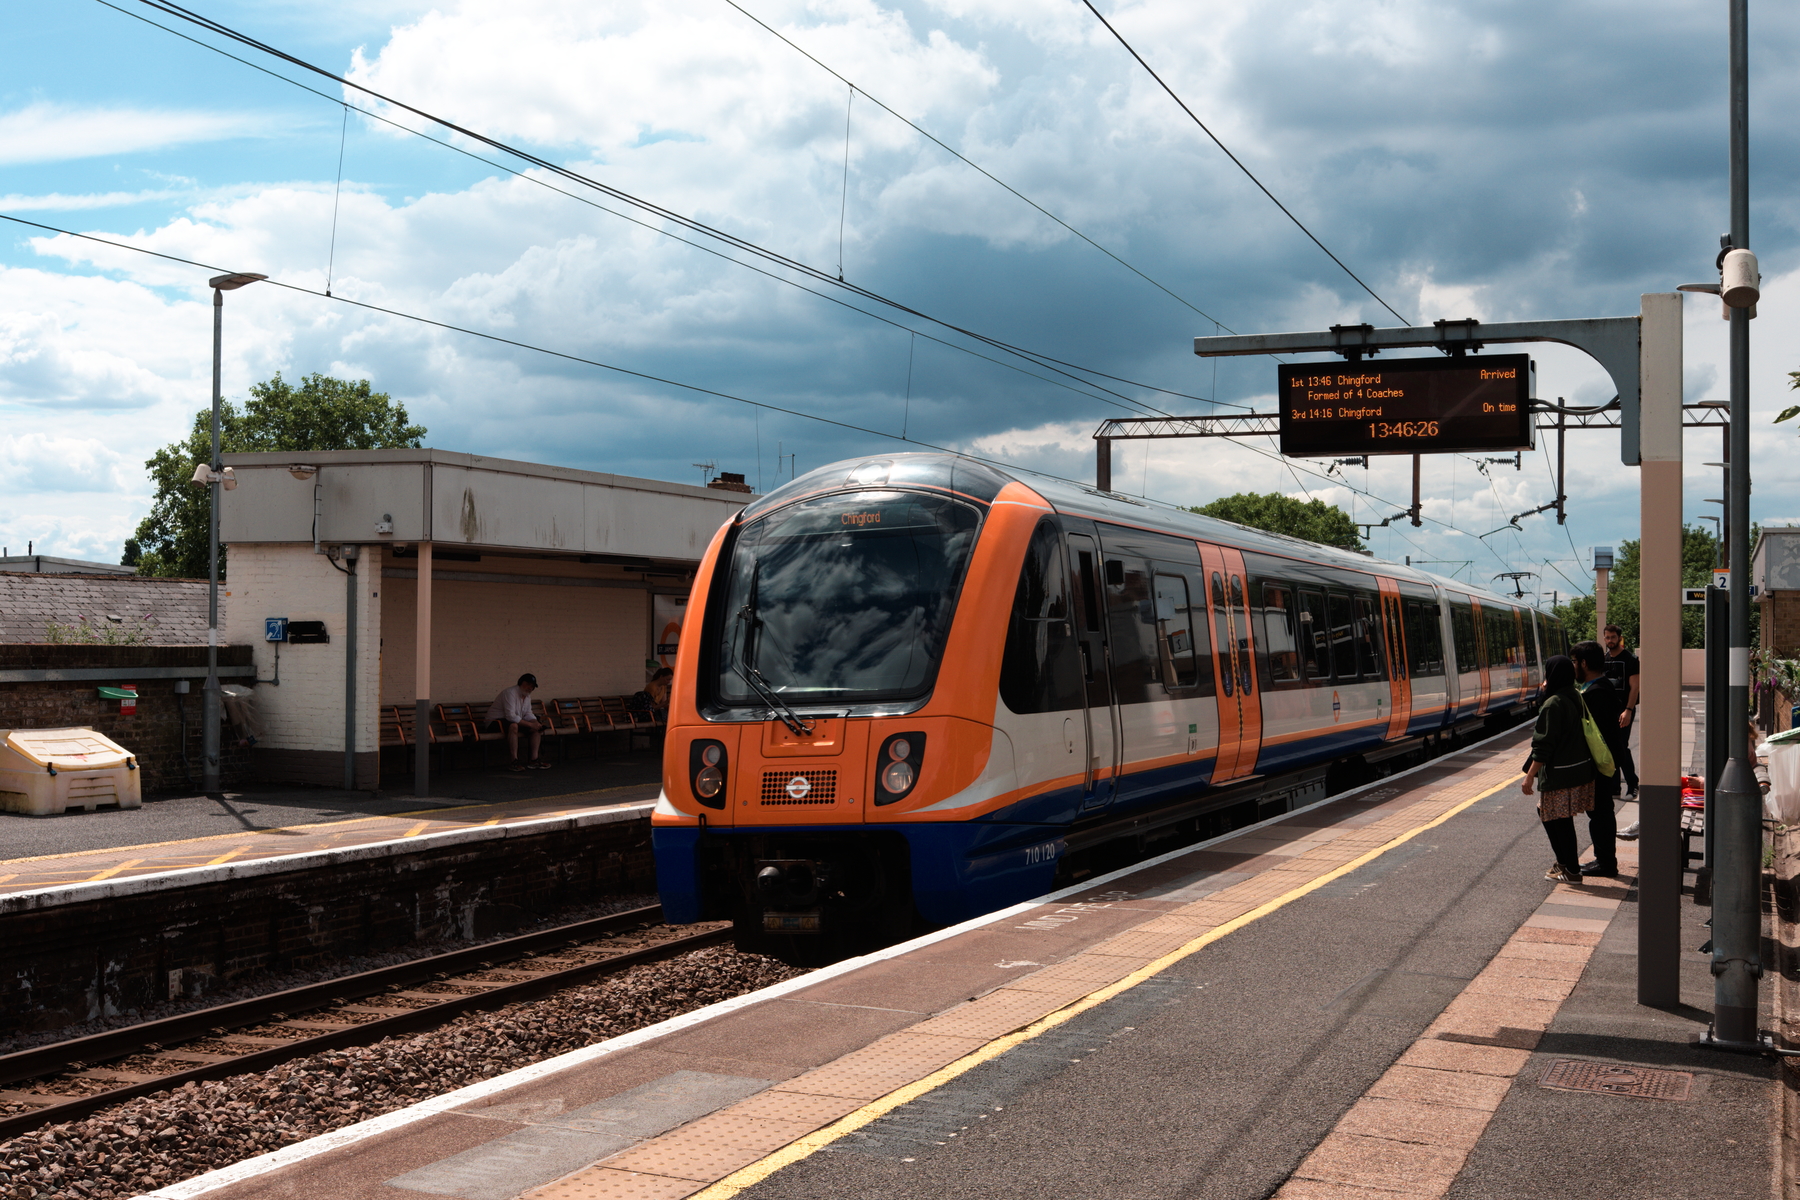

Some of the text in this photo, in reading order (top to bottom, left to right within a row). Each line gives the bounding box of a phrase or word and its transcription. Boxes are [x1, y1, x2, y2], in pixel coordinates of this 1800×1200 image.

[1291, 373, 1381, 387] 1st 13:46 Chingford
[1480, 368, 1516, 379] Arrived
[1308, 388, 1404, 400] Formed of 4 Coaches
[1291, 406, 1382, 419] 3rd 14:16 Chingford
[1482, 402, 1516, 412] On time
[1369, 421, 1439, 438] 13:46:26
[841, 511, 880, 526] Chingford
[1719, 576, 1727, 588] 2
[1025, 843, 1055, 865] 710 120
